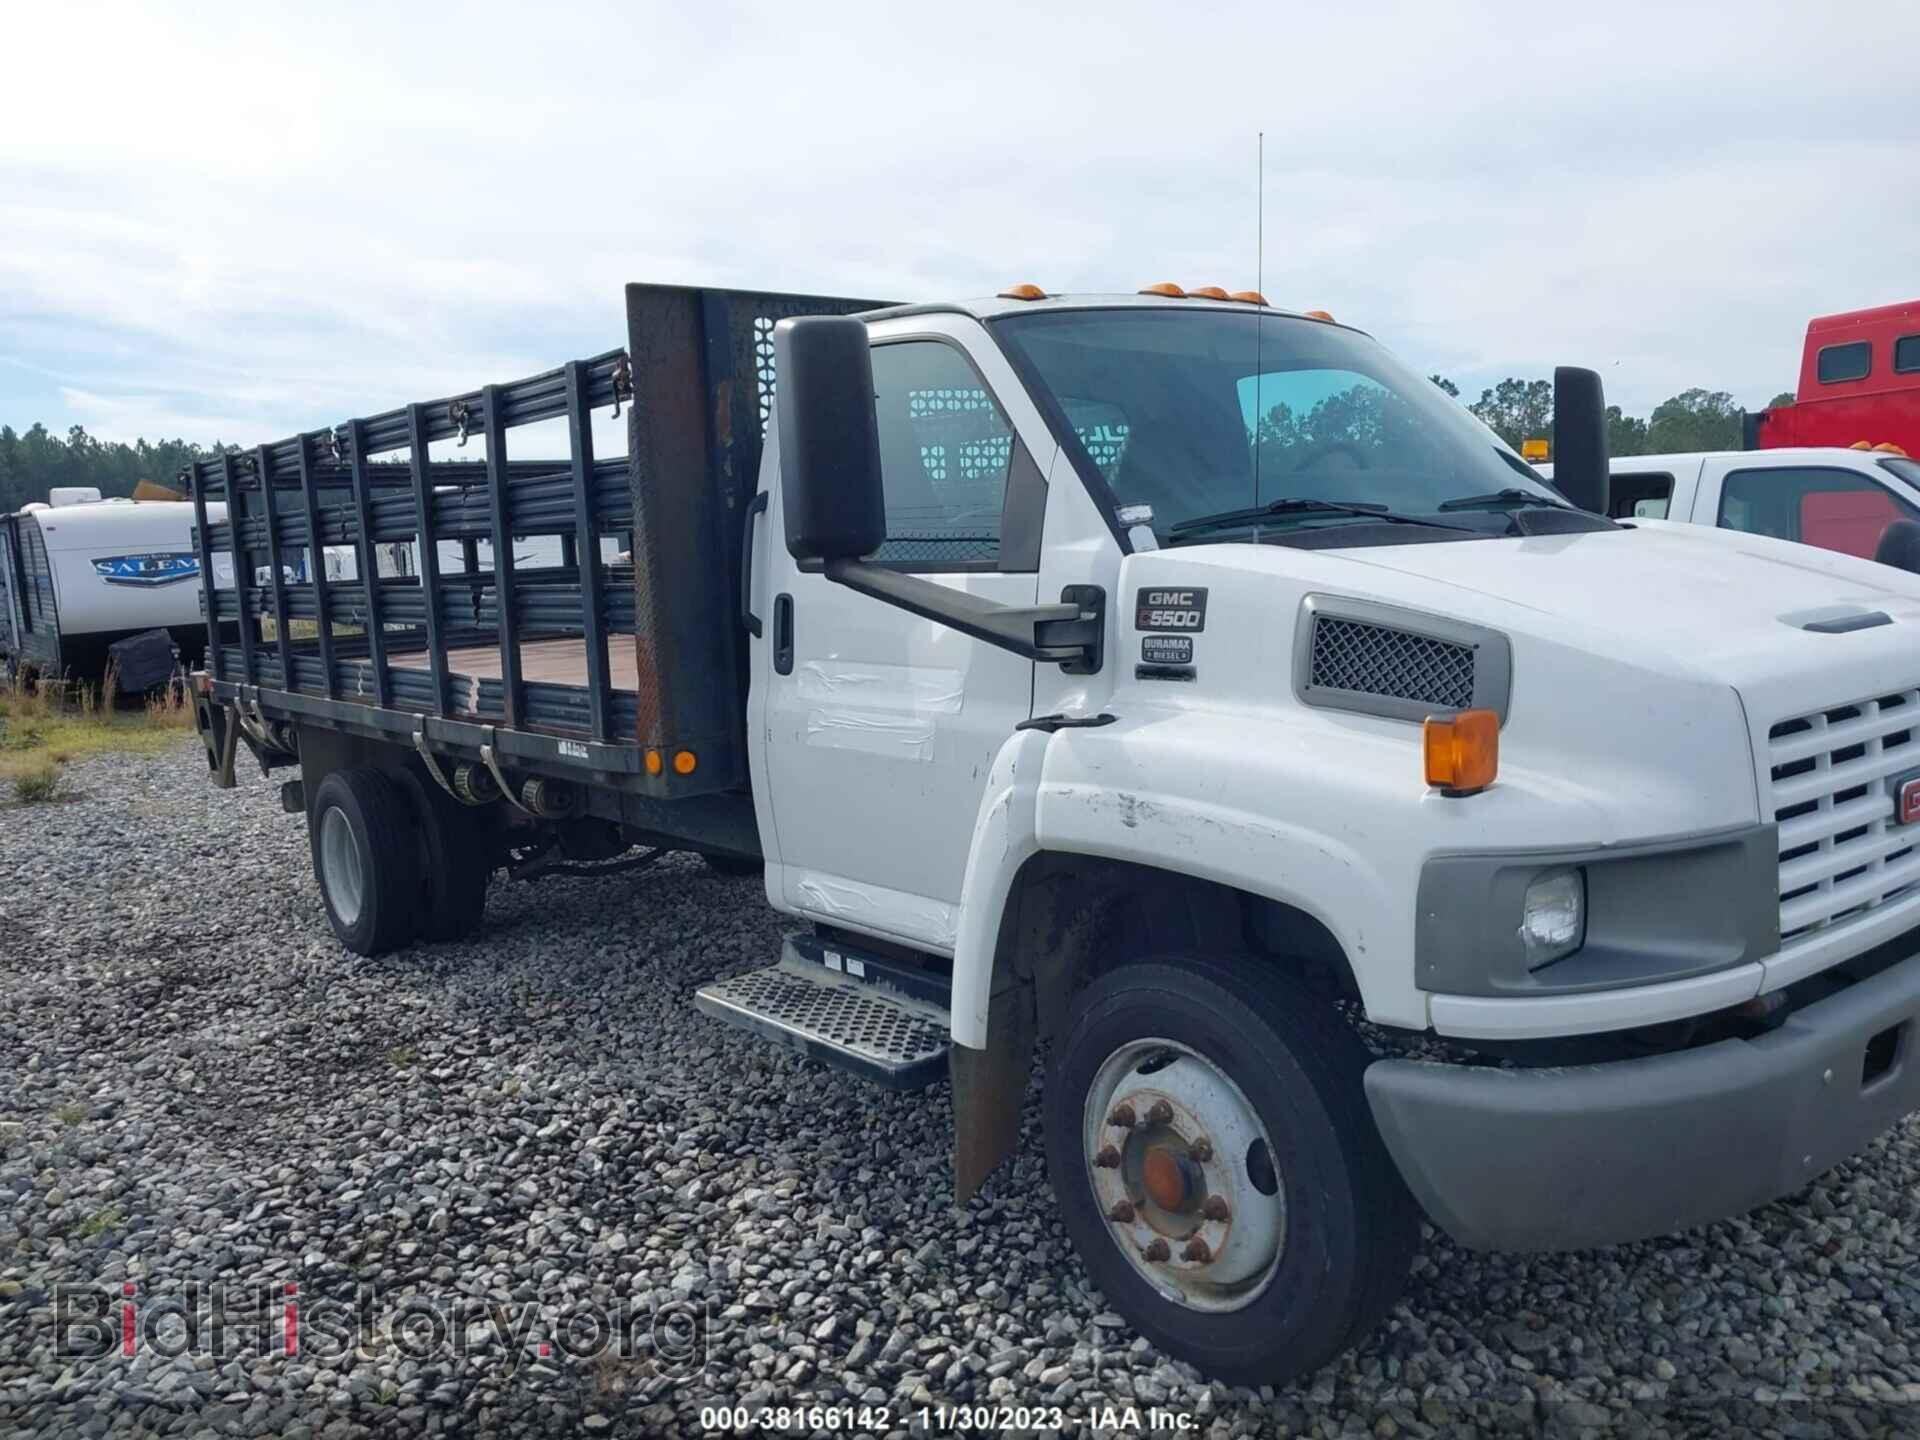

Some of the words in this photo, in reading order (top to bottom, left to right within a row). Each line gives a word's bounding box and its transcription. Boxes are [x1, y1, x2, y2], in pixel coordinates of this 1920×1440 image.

[96, 559, 200, 574] SALEM
[1148, 592, 1194, 606] GMC
[1140, 609, 1201, 627] C5500
[1144, 639, 1191, 649] DURAMAX
